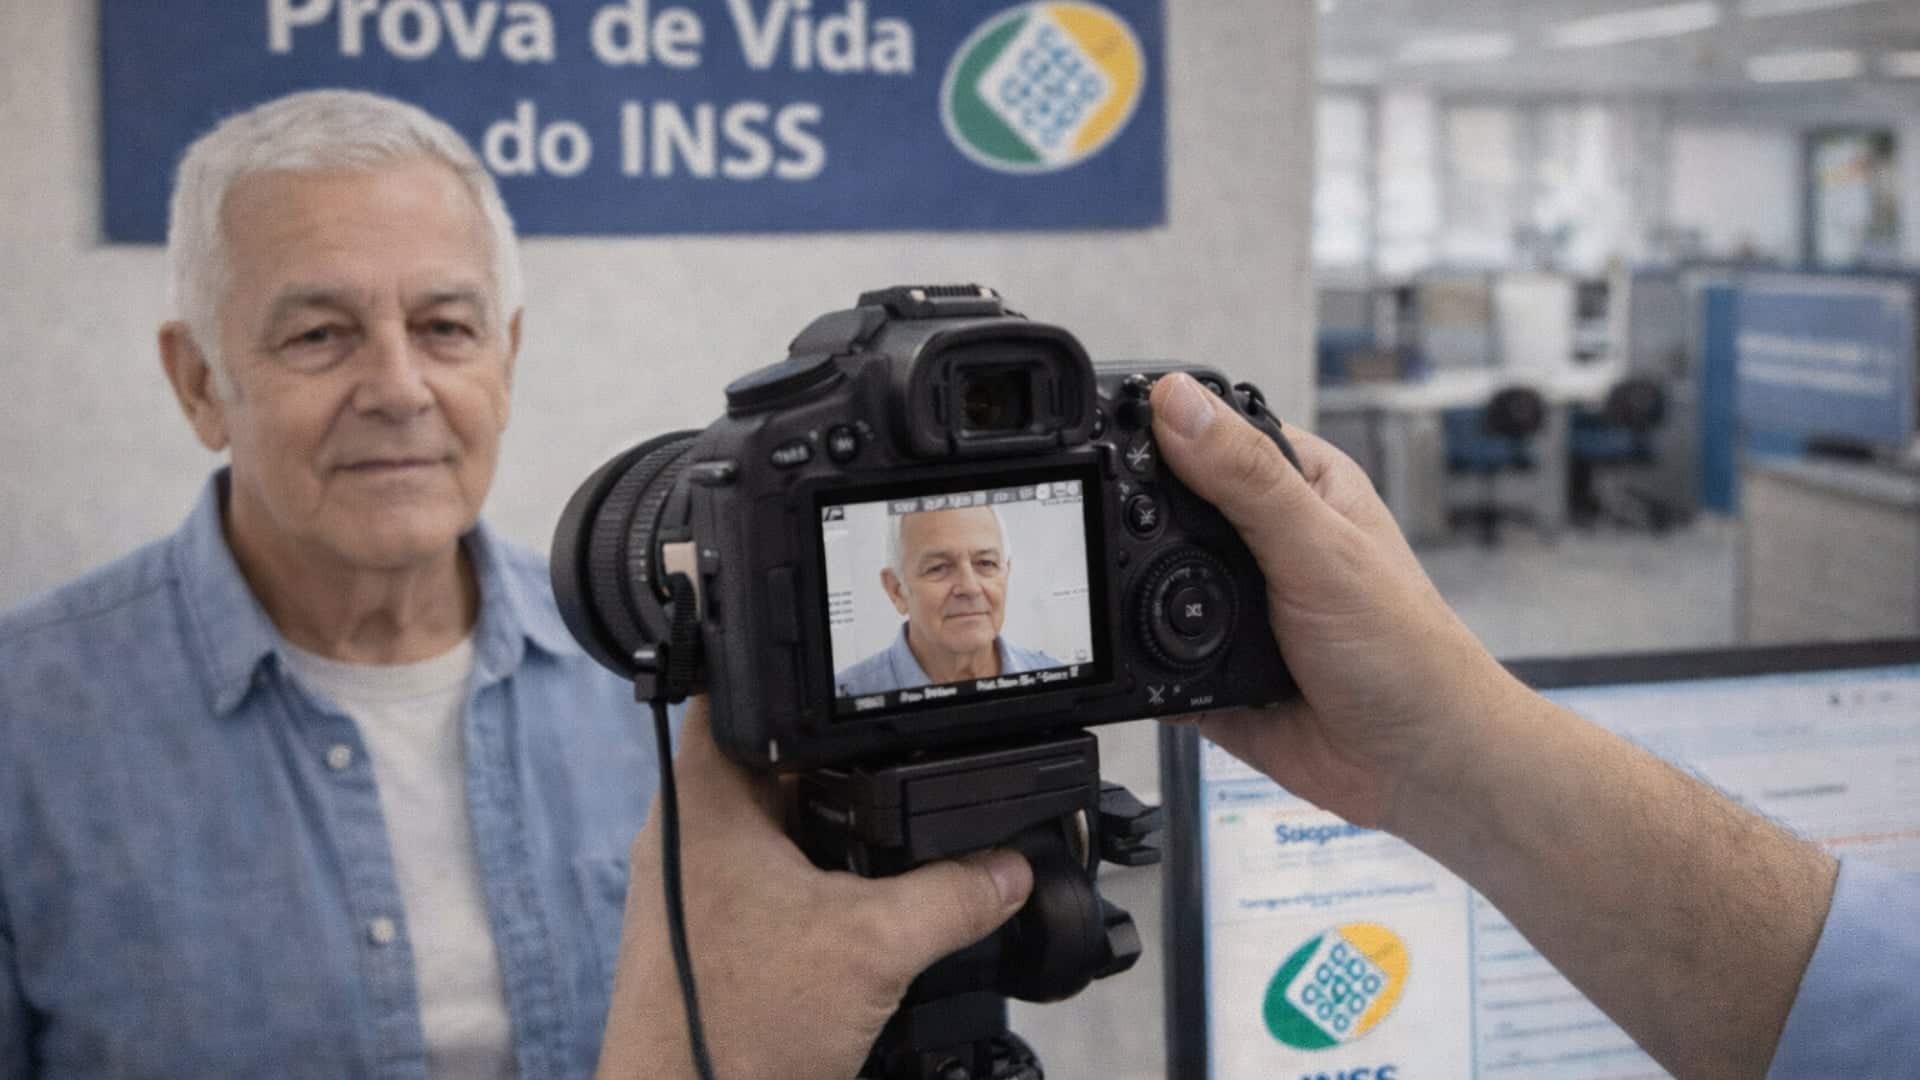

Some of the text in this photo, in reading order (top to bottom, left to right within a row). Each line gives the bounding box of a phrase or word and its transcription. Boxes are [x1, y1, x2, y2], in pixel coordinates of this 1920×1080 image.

[268, 0, 915, 73] Prova de Vida
[484, 102, 826, 180] do INSS
